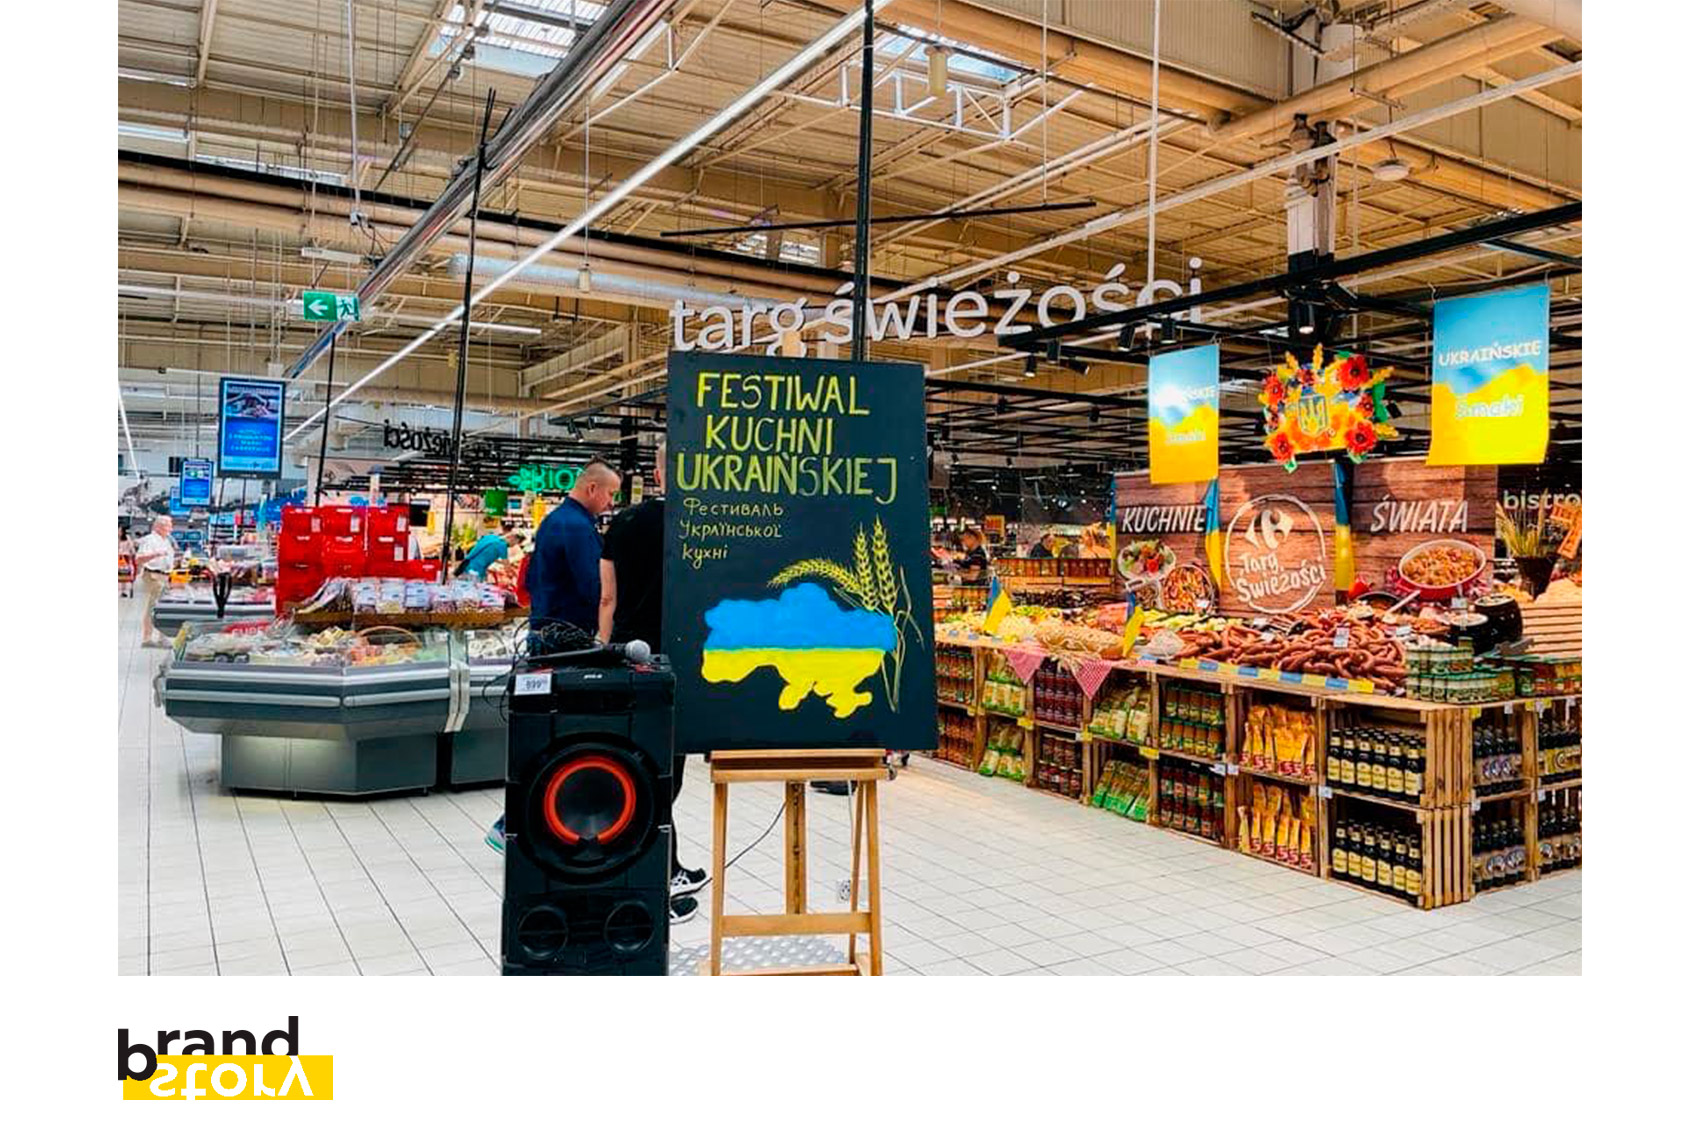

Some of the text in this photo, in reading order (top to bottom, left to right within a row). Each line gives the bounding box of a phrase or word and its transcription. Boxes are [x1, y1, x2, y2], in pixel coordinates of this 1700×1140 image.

[669, 297, 808, 358] targ
[1438, 340, 1541, 366] UKRAIŃSKIE
[696, 372, 871, 416] FESTIWAL
[705, 414, 834, 456] KUCHNI
[676, 451, 898, 505] UKRAIŃSKIEJ
[683, 497, 784, 516] Фестиваль
[1121, 504, 1206, 534] KUCHNIE
[1370, 494, 1468, 533] ŚWIATA
[1503, 489, 1582, 510] bistro
[1236, 556, 1328, 603] Świeżości
[1238, 550, 1279, 575] Targ
